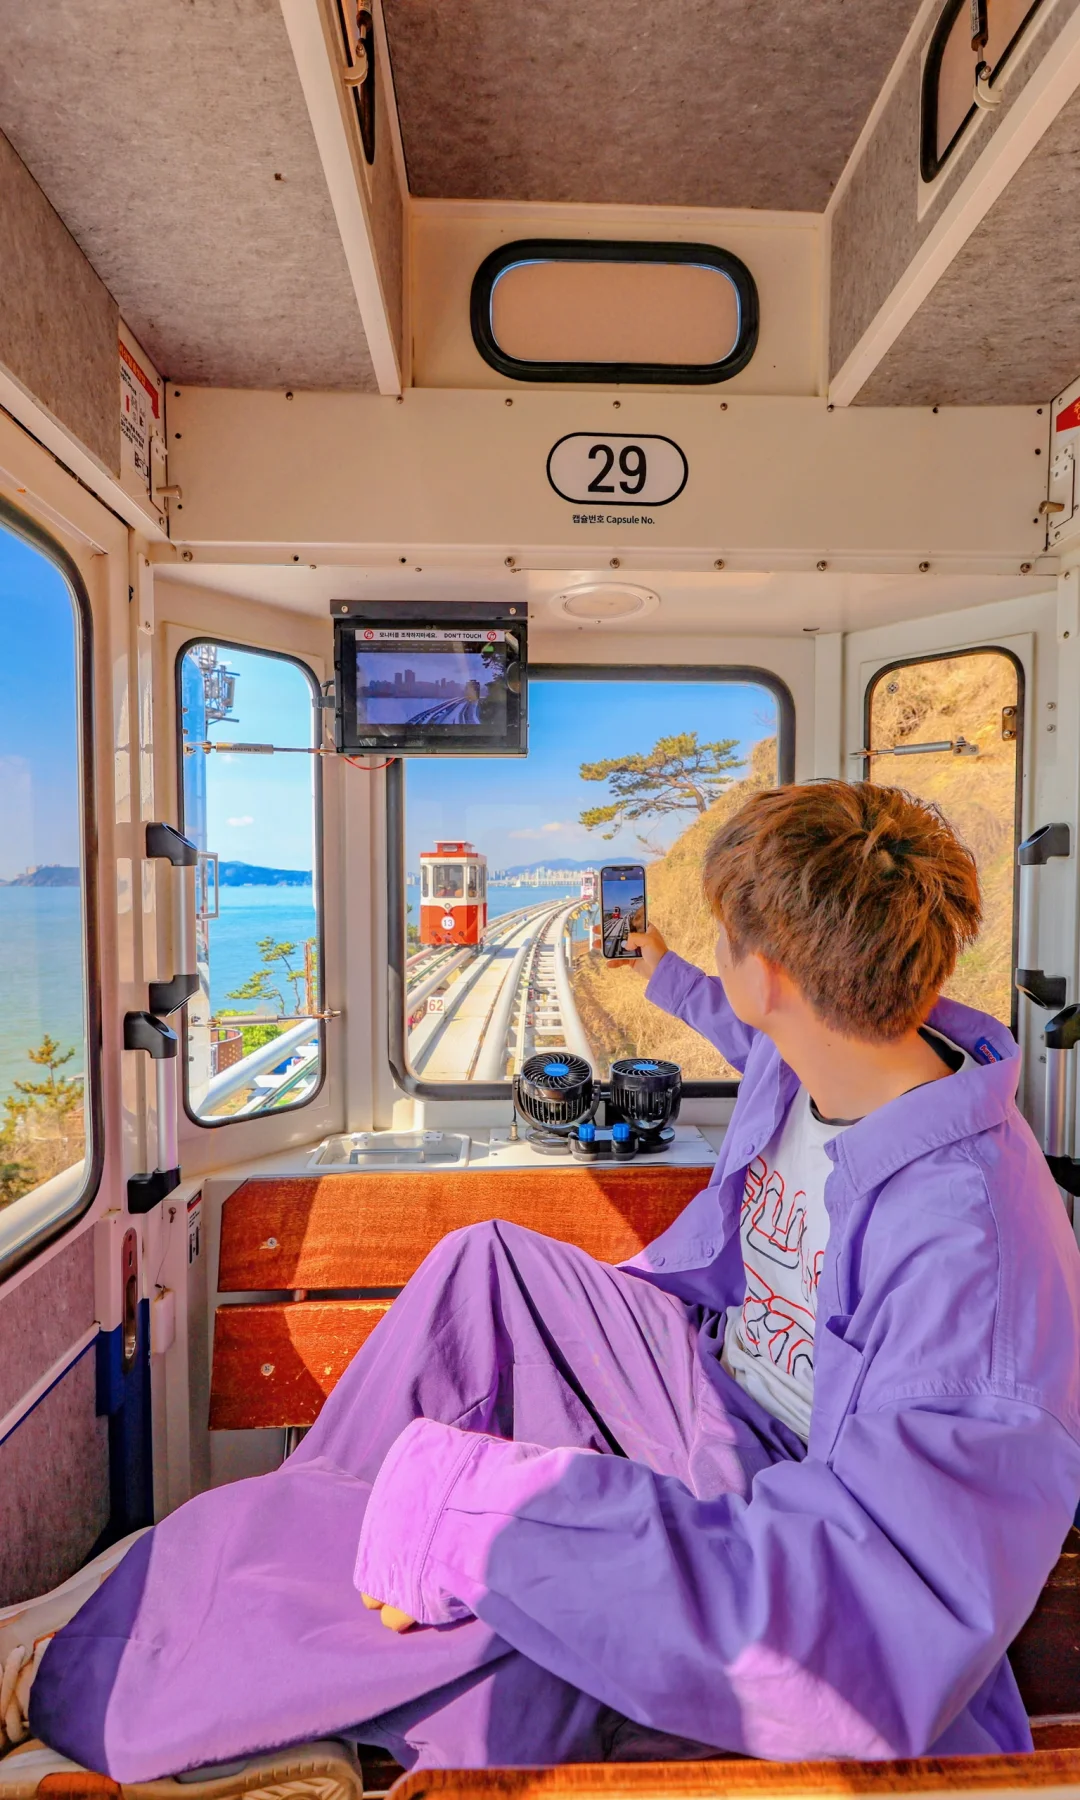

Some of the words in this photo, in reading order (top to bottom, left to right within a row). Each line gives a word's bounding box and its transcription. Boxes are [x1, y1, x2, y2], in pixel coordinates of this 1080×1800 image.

[588, 444, 647, 494] 29
[572, 514, 605, 524] 캡슐번호
[606, 515, 640, 525] Capsule
[641, 516, 655, 524] No.
[443, 919, 453, 927] 13
[429, 999, 444, 1012] 62
